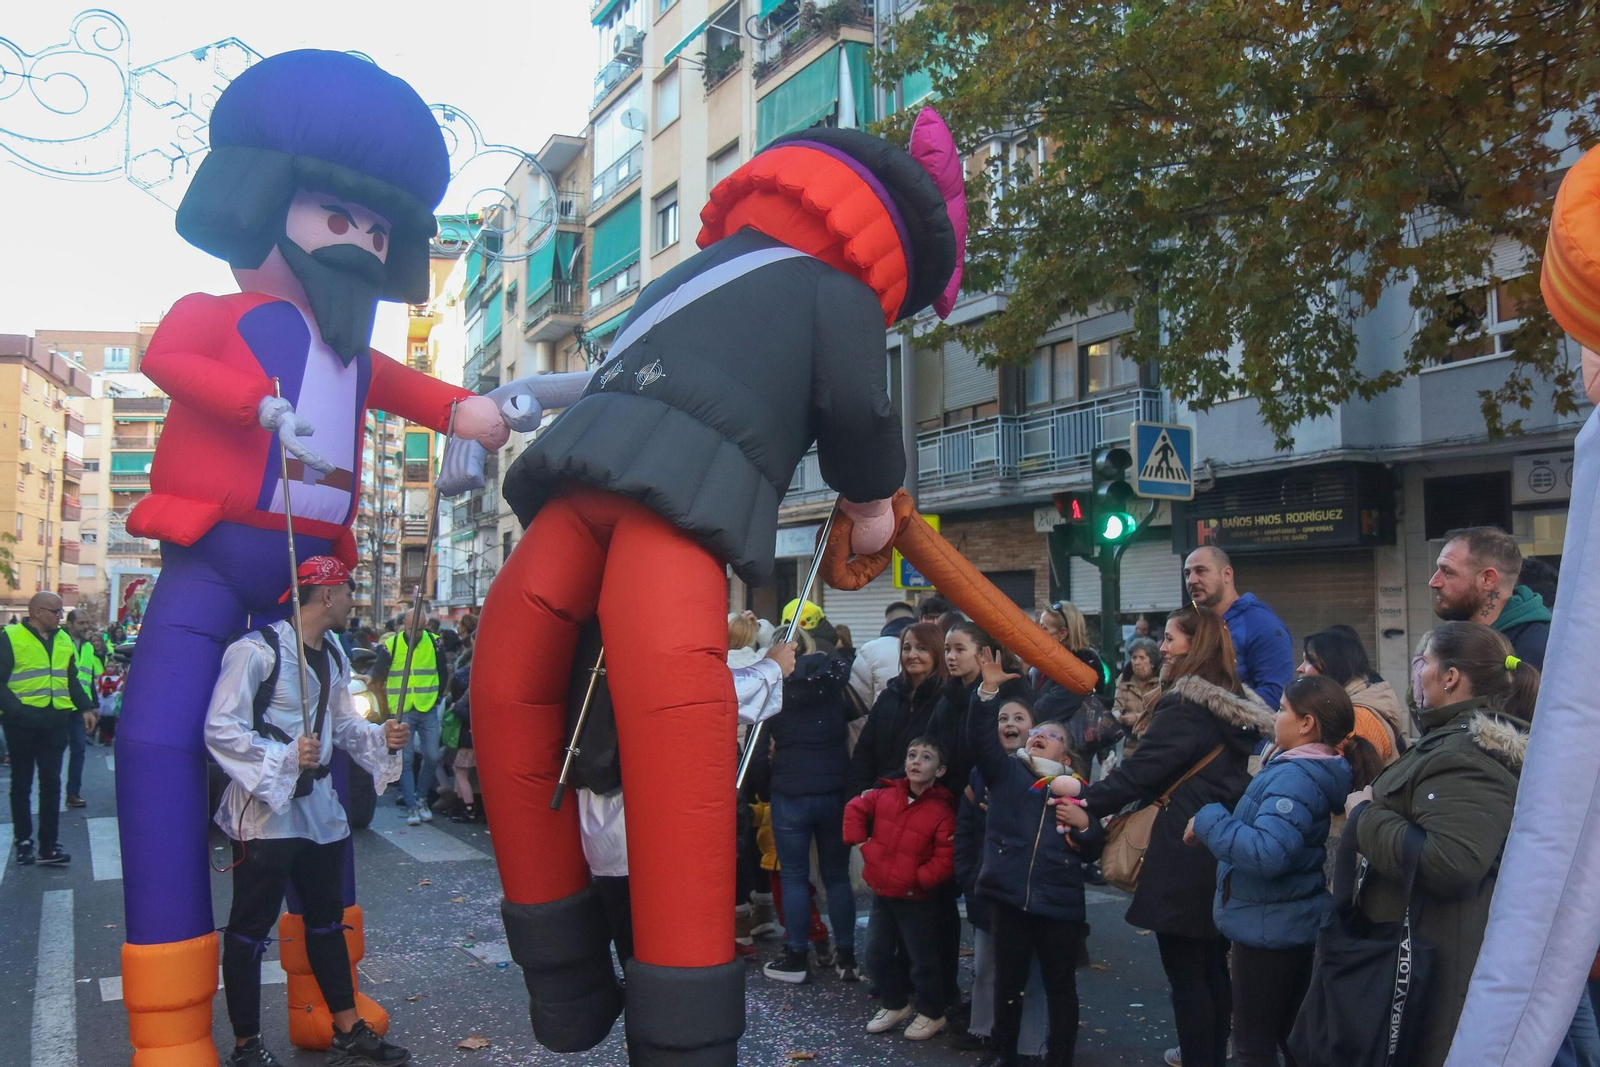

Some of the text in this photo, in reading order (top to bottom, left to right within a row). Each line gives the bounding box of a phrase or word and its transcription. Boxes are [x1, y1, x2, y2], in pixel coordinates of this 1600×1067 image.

[1222, 509, 1343, 528] BAÑOS HNOS. RODRÍGUEZ
[1397, 938, 1410, 984] LOLA
